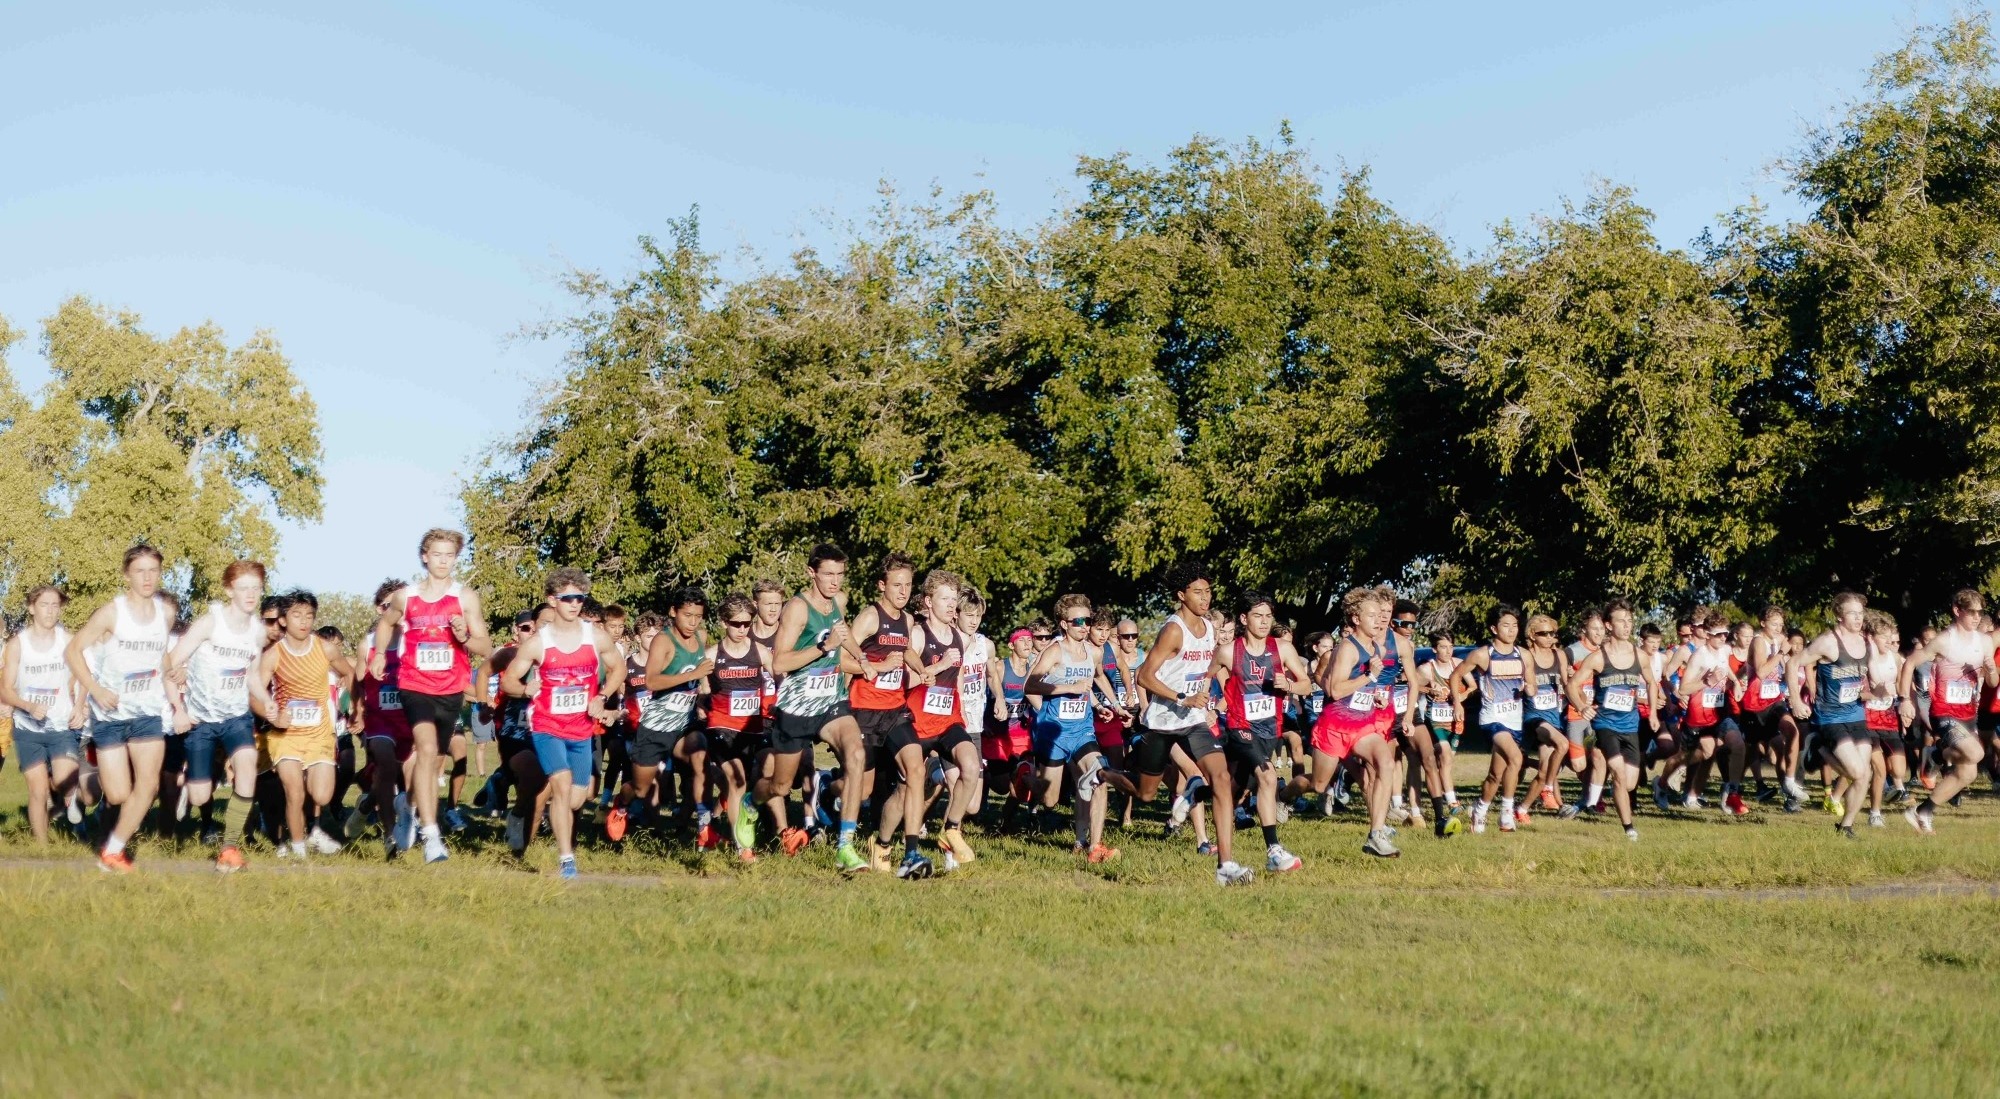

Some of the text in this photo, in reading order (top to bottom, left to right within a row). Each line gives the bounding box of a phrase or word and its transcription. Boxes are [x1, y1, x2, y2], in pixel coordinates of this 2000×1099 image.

[420, 650, 451, 663] 1810
[1182, 650, 1202, 661] ARBOR
[718, 668, 758, 679] CADENCE
[1065, 667, 1092, 677] BASIC
[124, 679, 151, 693] 1681
[809, 674, 836, 690] 1703
[963, 680, 982, 695] 493
[555, 694, 585, 707] 1813
[671, 693, 697, 706] 1704
[733, 698, 759, 710] 2200
[927, 693, 953, 708] 2195
[1248, 699, 1273, 713] 1747
[1608, 693, 1633, 707] 2252
[1061, 701, 1086, 713] 1523
[1496, 702, 1518, 714] 1636
